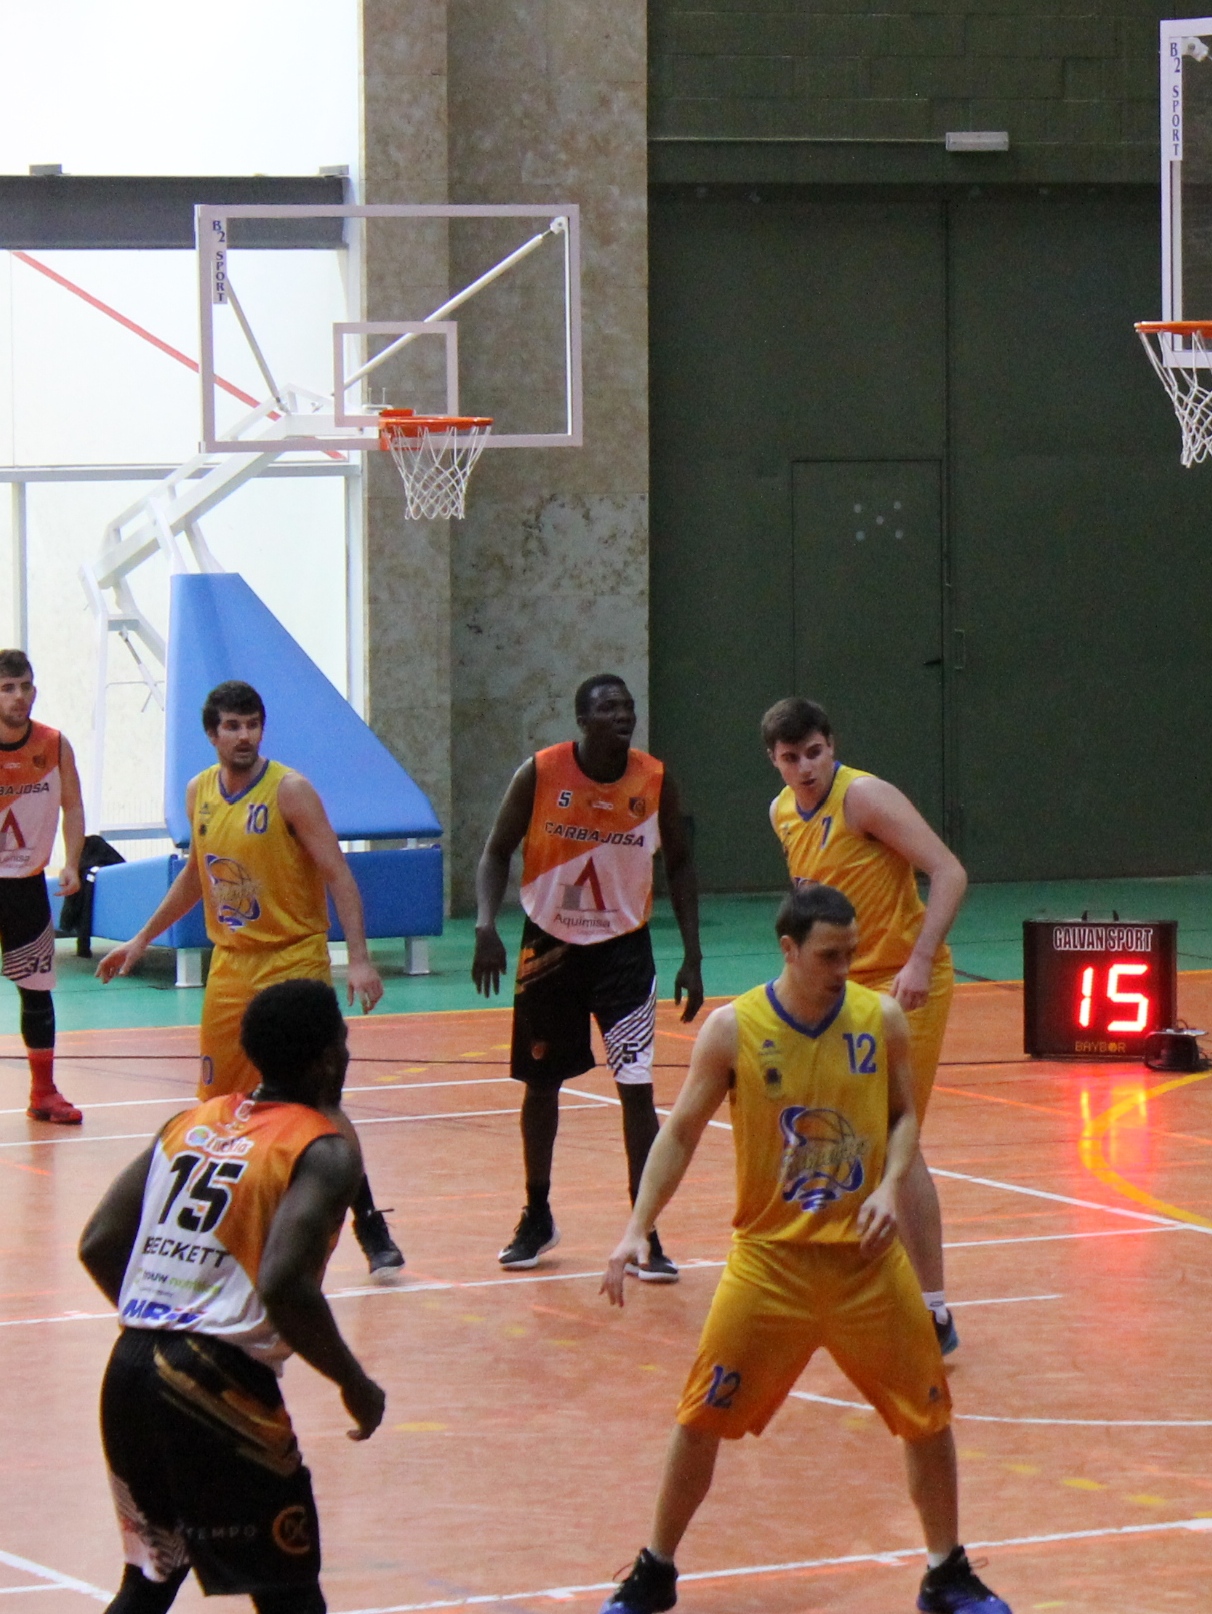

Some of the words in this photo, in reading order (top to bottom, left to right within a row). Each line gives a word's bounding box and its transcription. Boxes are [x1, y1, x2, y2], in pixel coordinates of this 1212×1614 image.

[1171, 85, 1181, 156] SPORT
[215, 250, 225, 302] SPORT
[244, 803, 269, 835] 10
[557, 789, 574, 808] 5
[544, 822, 645, 848] CARBAJOSA
[1053, 927, 1105, 951] GALVAN
[1106, 927, 1153, 951] SPORT
[1078, 963, 1150, 1032] 15
[842, 1031, 877, 1075] 12
[157, 1152, 250, 1235] 15
[703, 1364, 742, 1410] 12
